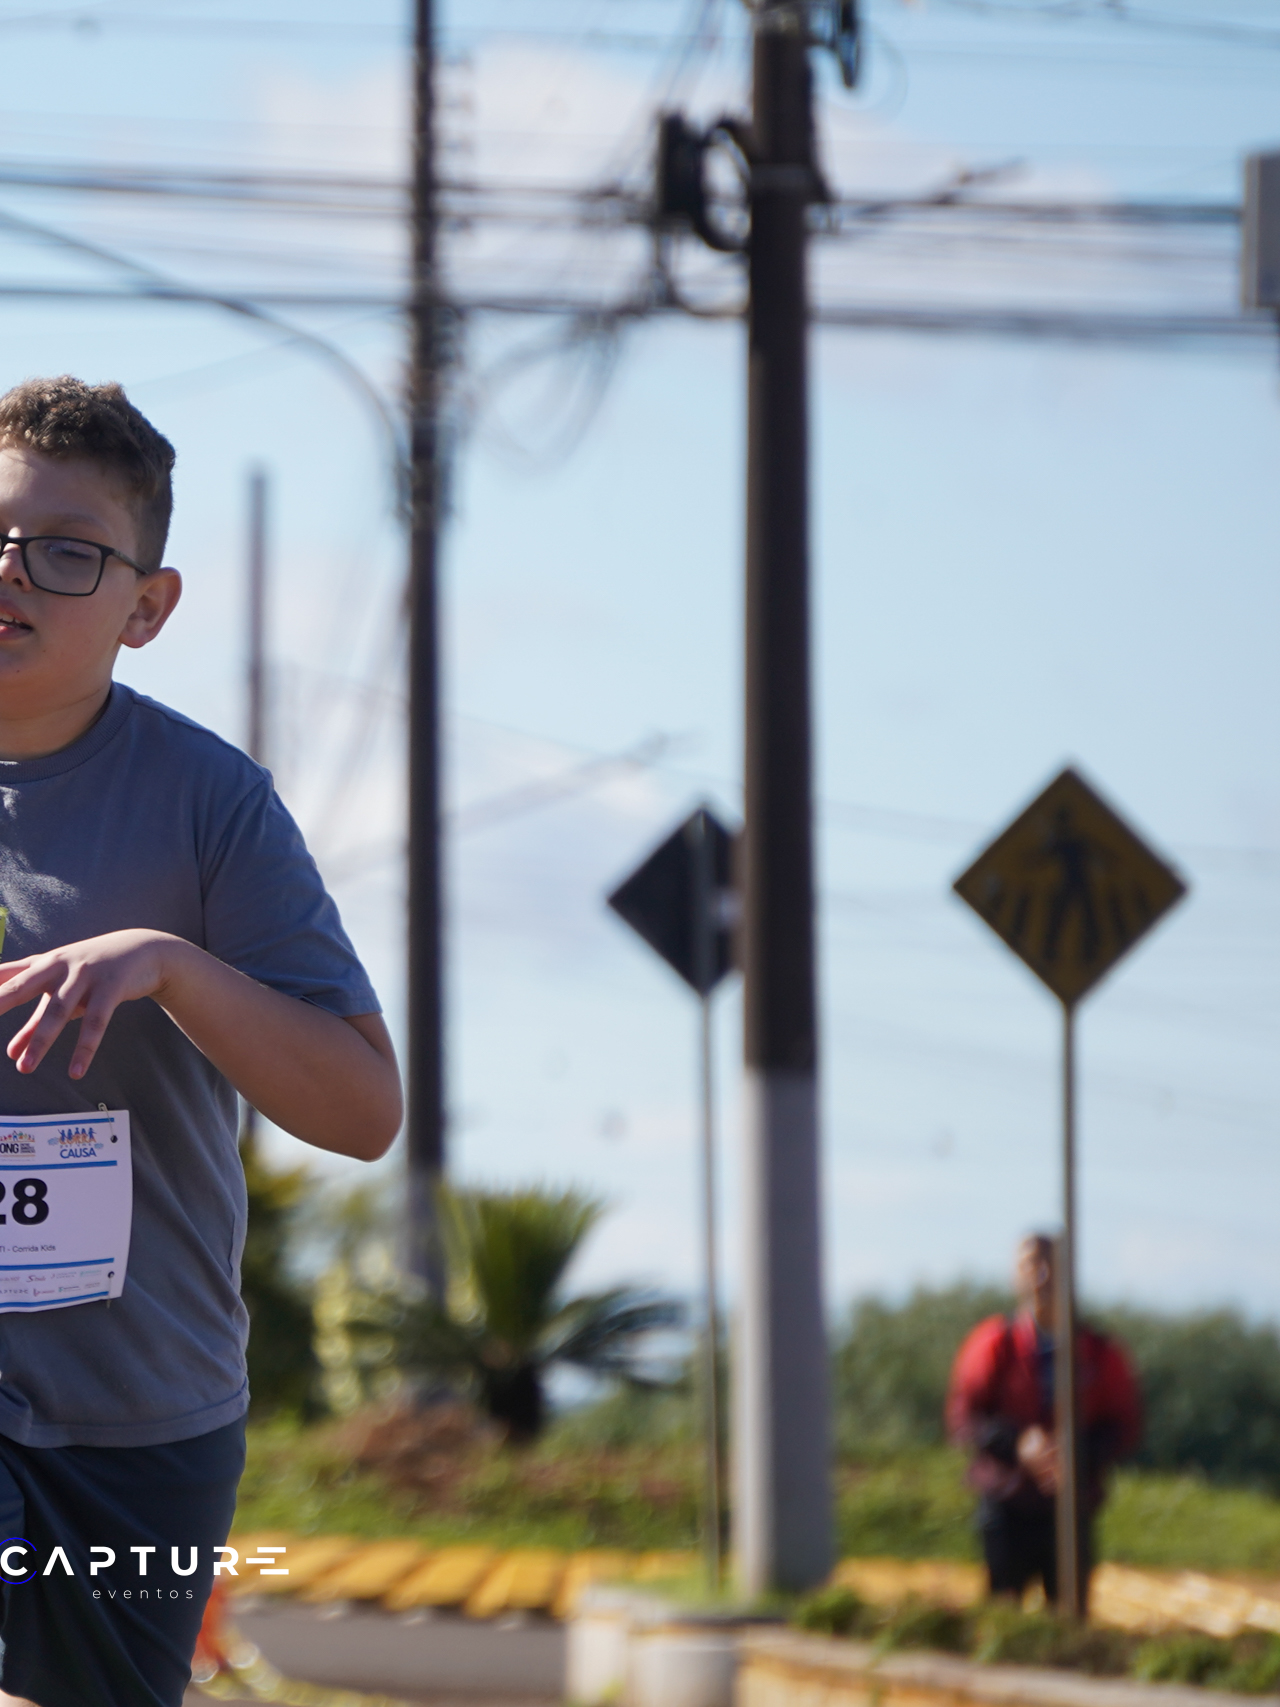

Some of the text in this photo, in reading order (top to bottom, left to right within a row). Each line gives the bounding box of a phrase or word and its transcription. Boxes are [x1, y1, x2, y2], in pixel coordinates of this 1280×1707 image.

[0, 1143, 19, 1154] ONG
[60, 1148, 97, 1159] CAUSA
[12, 1245, 39, 1253] Corrida
[41, 1244, 56, 1252] Kids
